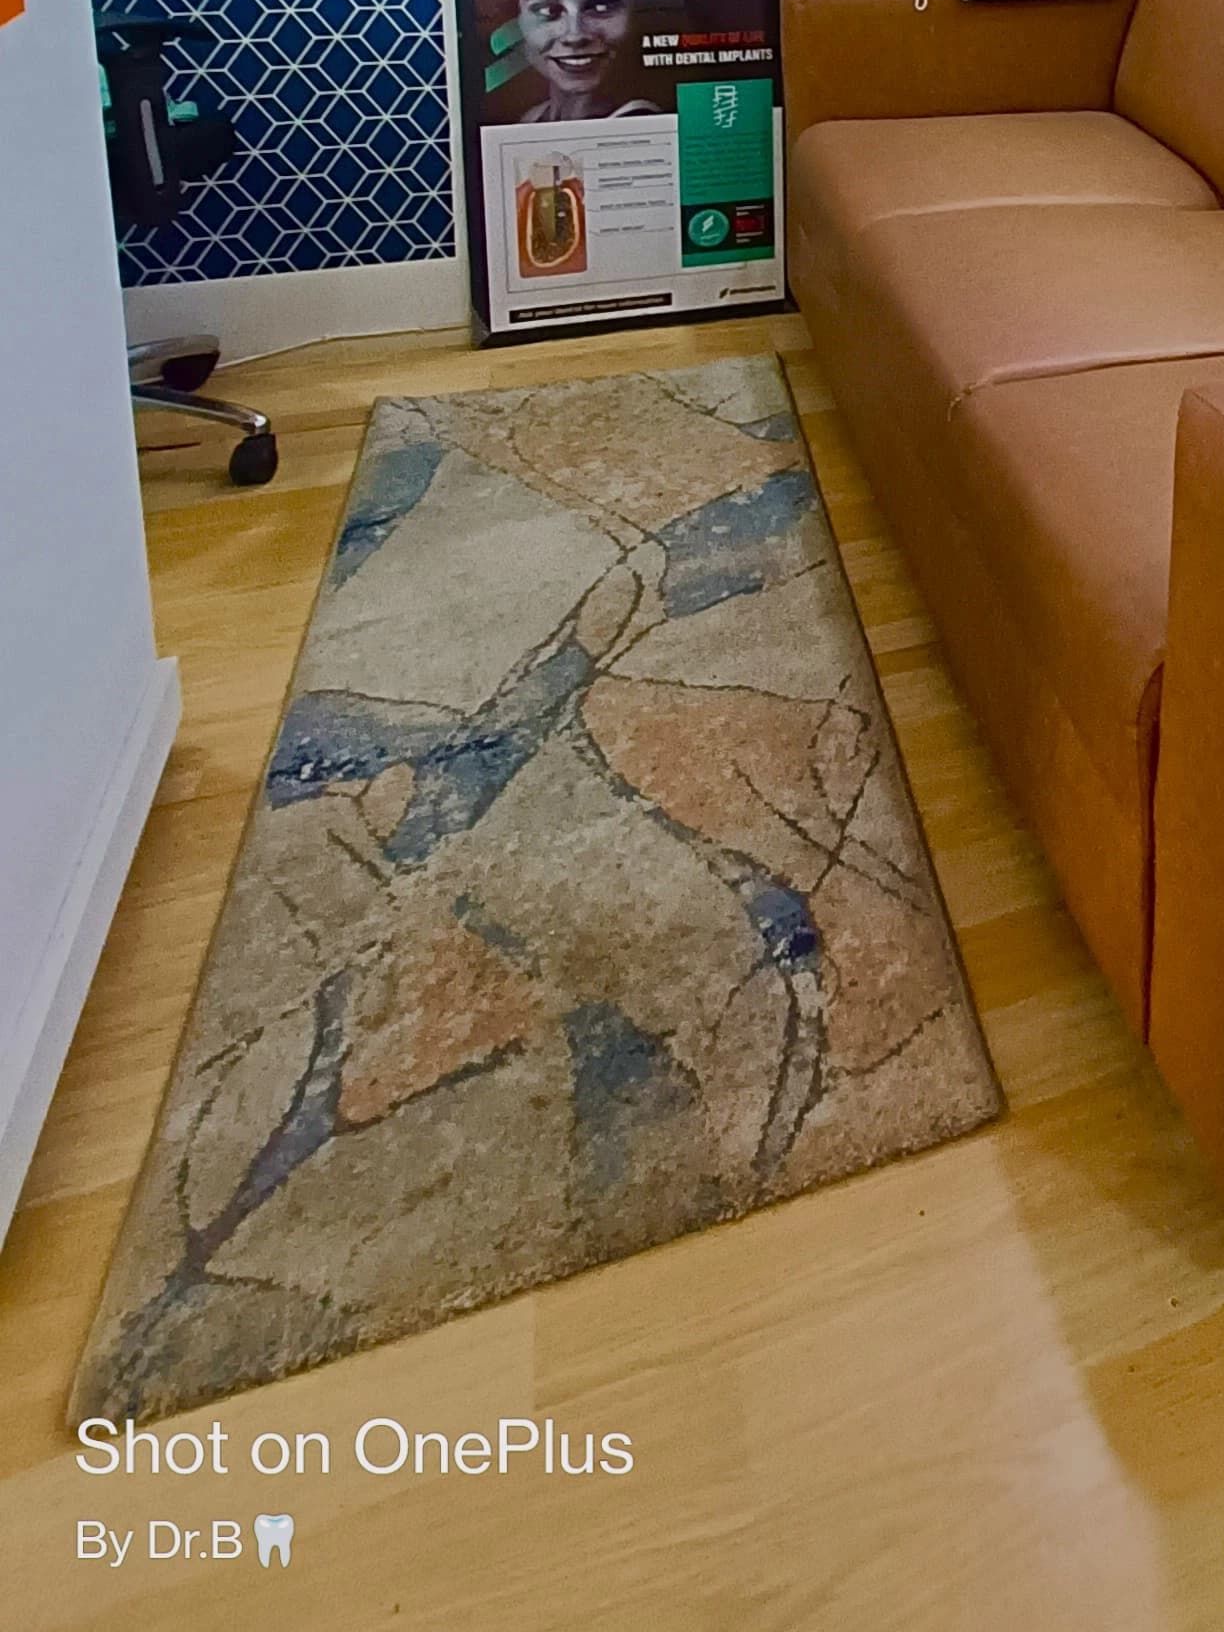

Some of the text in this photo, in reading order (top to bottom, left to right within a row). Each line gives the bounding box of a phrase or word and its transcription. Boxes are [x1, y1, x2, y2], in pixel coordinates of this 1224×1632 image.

[643, 35, 651, 48] A
[653, 34, 679, 48] NEW
[643, 48, 774, 67] WITH DENTAL IMPLANTS
